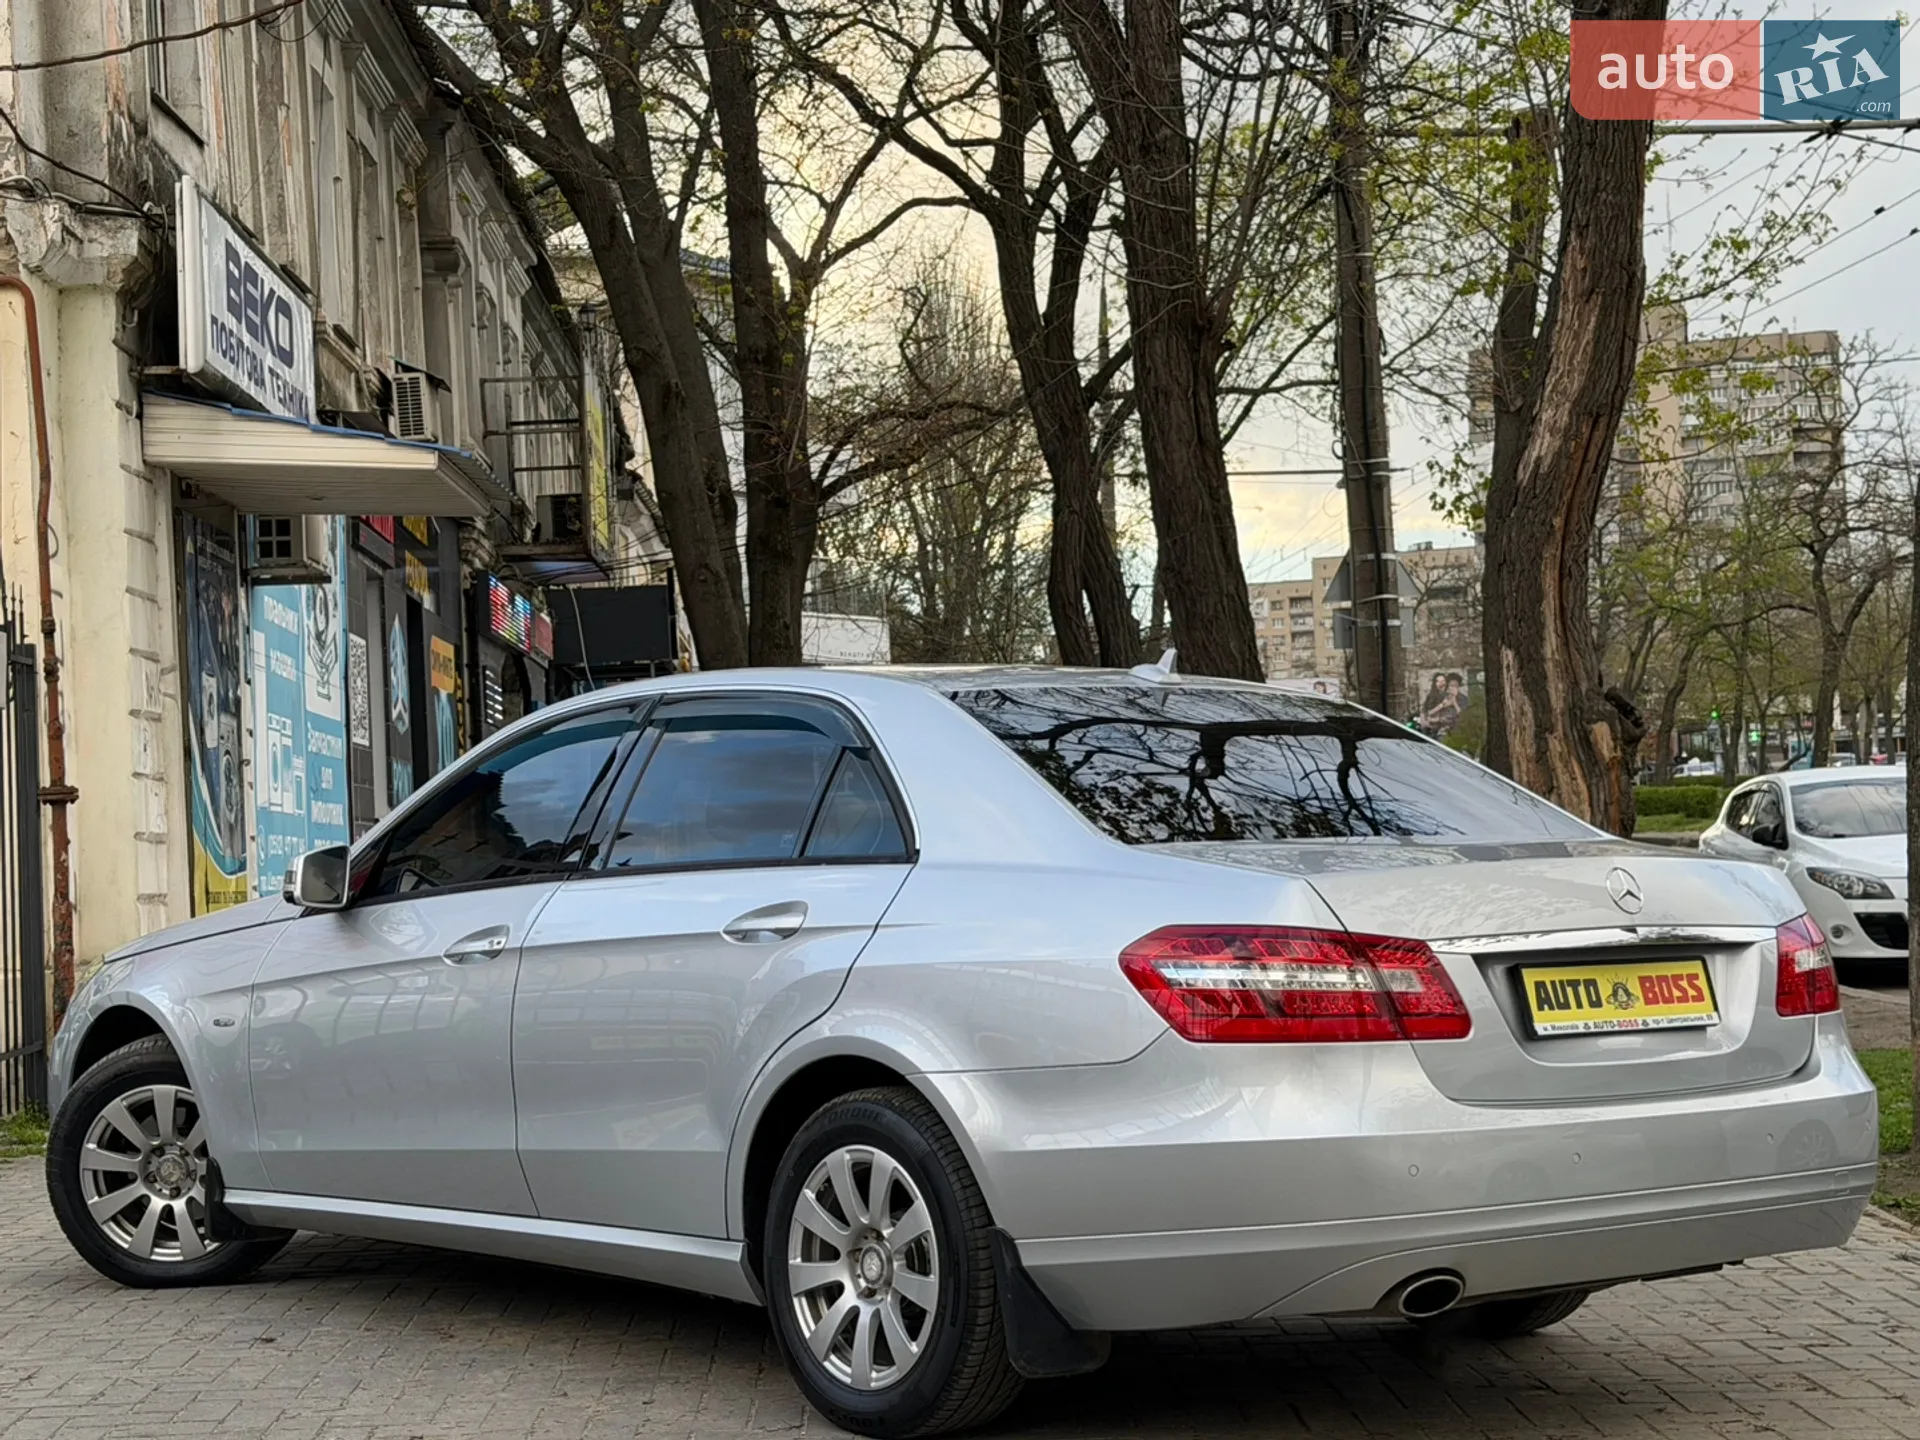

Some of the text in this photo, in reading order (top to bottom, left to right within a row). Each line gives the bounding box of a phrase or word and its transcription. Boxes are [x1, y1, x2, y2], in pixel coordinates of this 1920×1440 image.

[225, 238, 294, 369] BEKO
[1533, 973, 1705, 1011] AUTO BOSS
[1593, 1018, 1640, 1030] AUTO-BOSS
